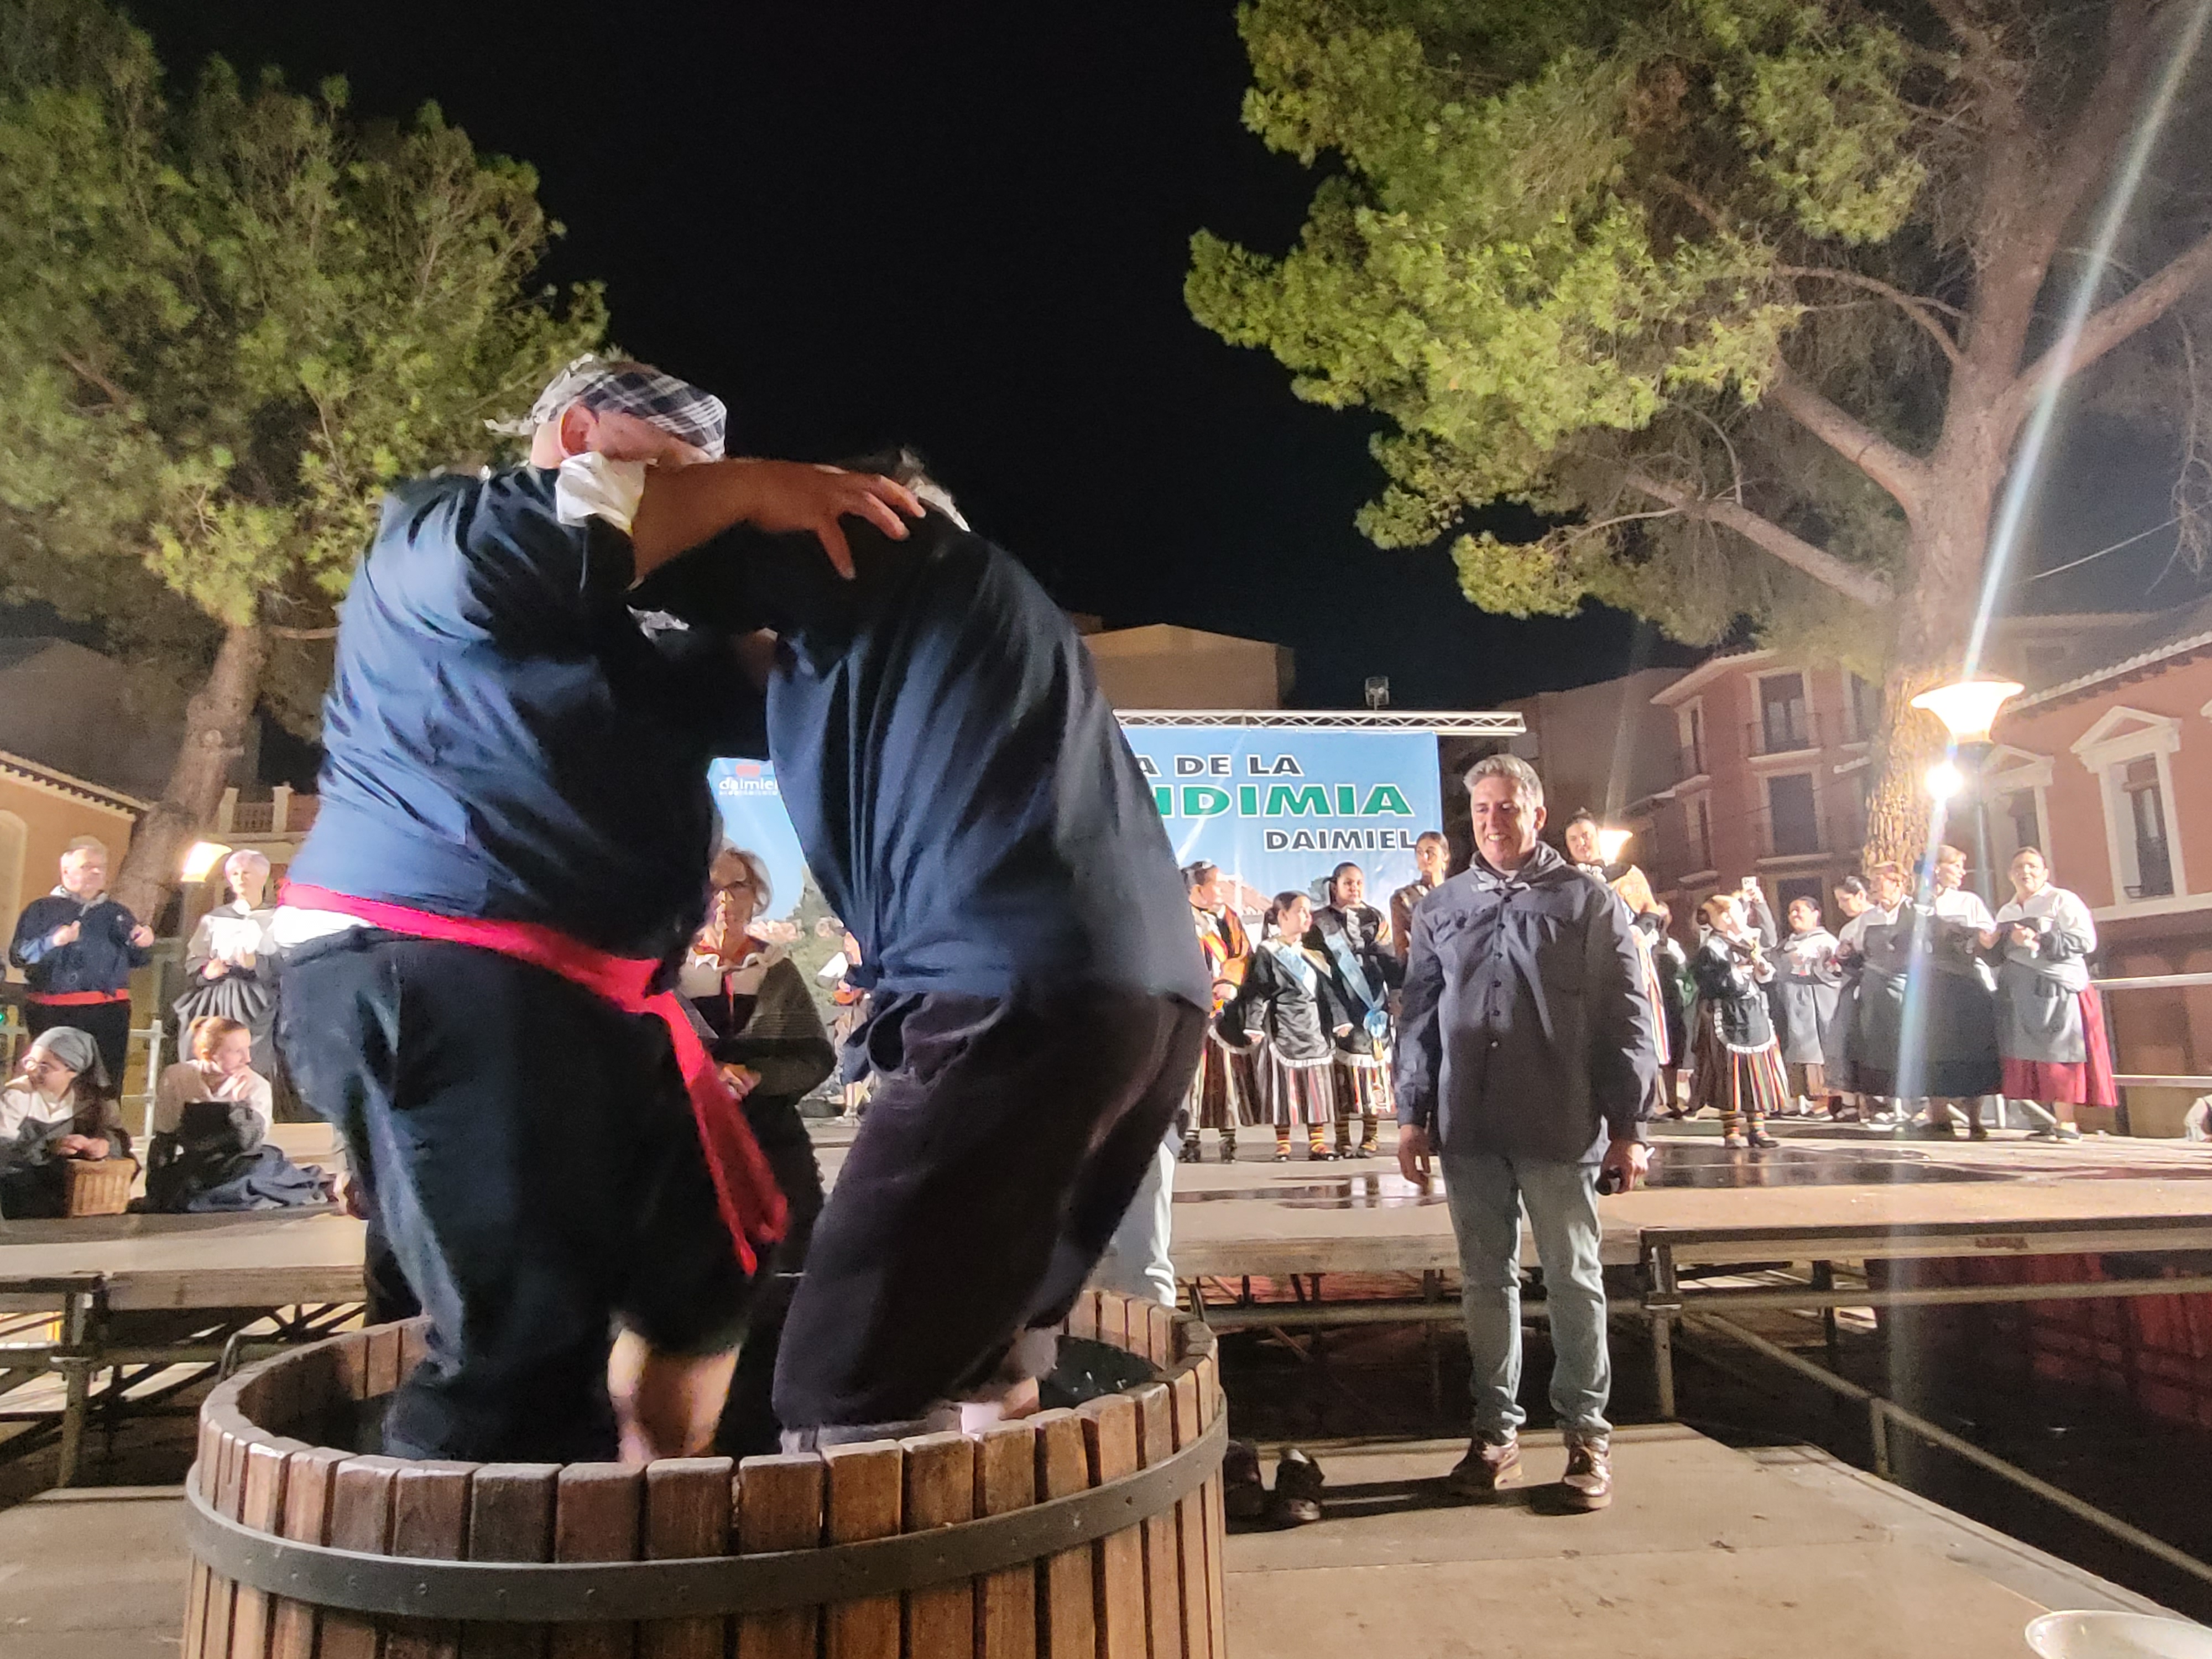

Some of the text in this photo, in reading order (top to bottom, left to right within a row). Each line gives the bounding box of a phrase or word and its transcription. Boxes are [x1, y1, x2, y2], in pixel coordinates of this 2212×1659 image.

[1176, 755, 1231, 775] DE
[1249, 755, 1302, 775] LA
[1265, 830, 1416, 851] DAIMIEL
